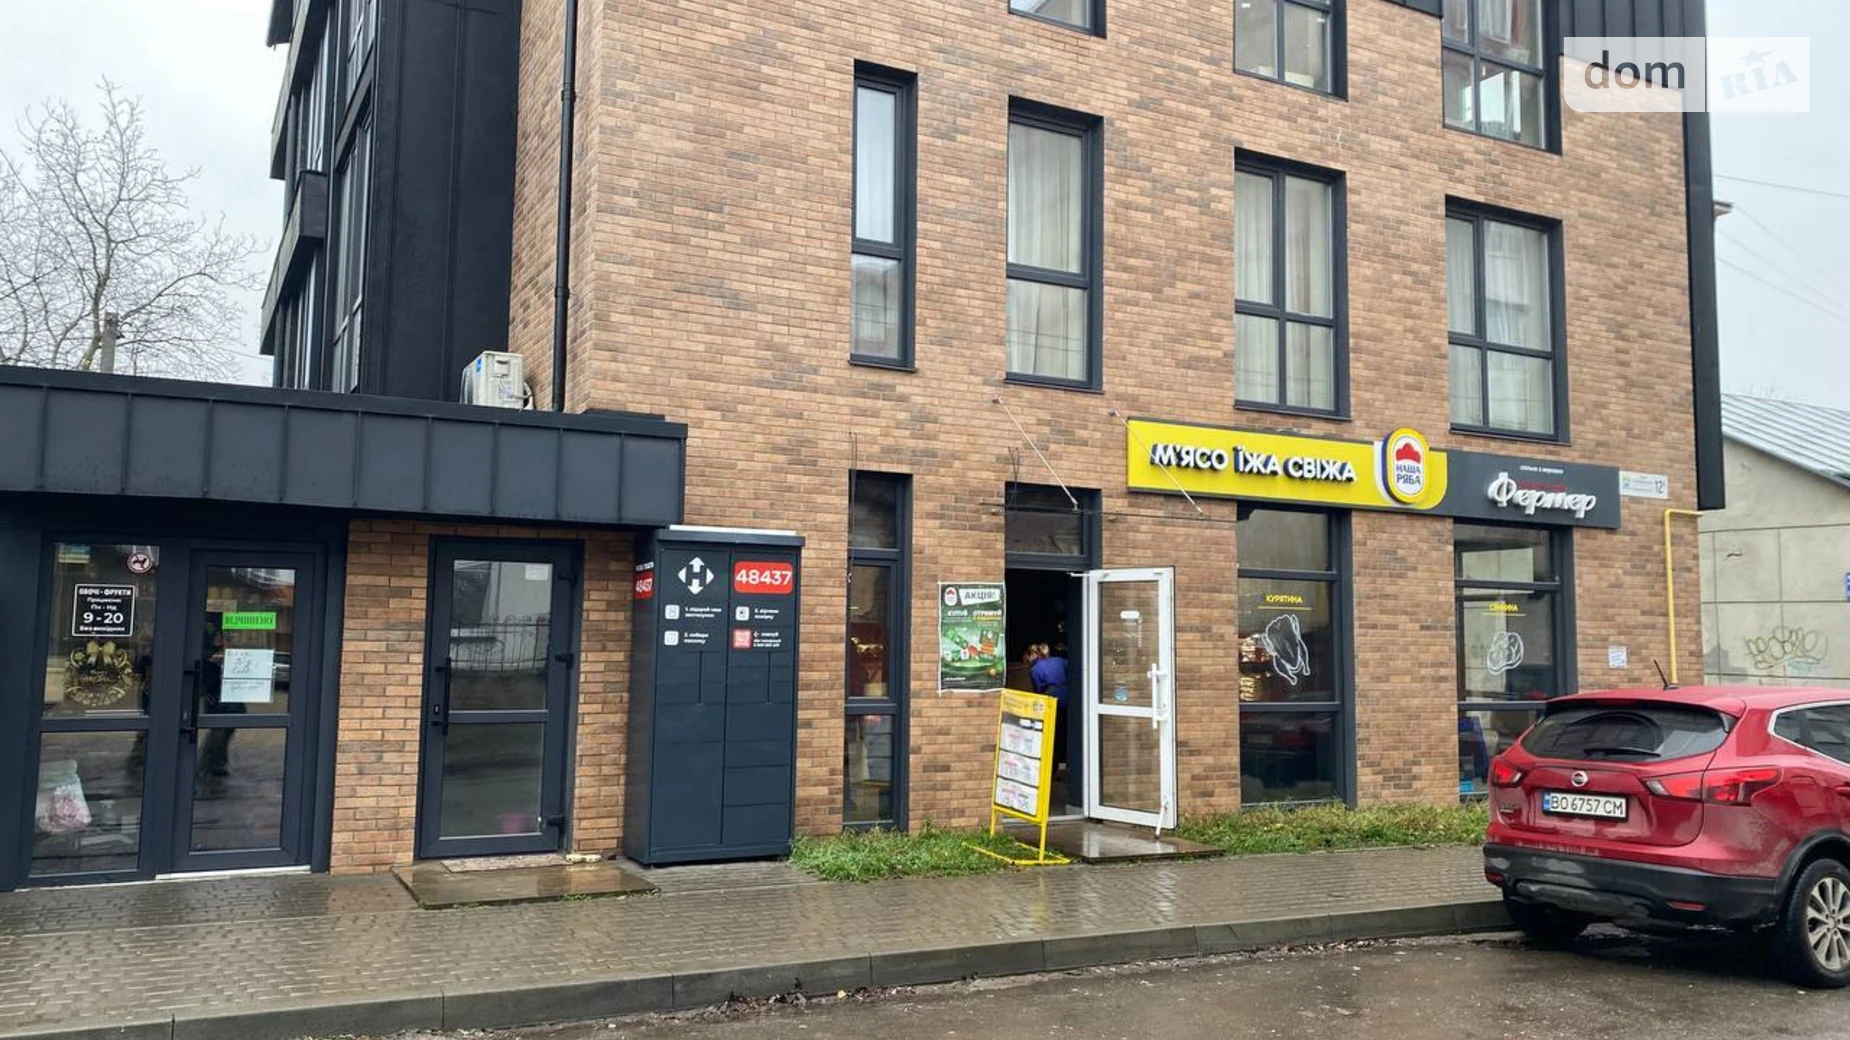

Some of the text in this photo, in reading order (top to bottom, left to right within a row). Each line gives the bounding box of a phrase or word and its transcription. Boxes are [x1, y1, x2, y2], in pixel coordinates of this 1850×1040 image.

[1153, 443, 1358, 482] М'ЯСО ЇЖА СВІЖА
[1395, 463, 1422, 475] НАША
[1395, 473, 1422, 486] РЯБА
[734, 568, 793, 586] 48437
[1265, 593, 1304, 605] КУРЯТИНА
[83, 612, 94, 624] 9
[103, 612, 124, 624] 20
[1550, 795, 1624, 816] BO 6757 CM
